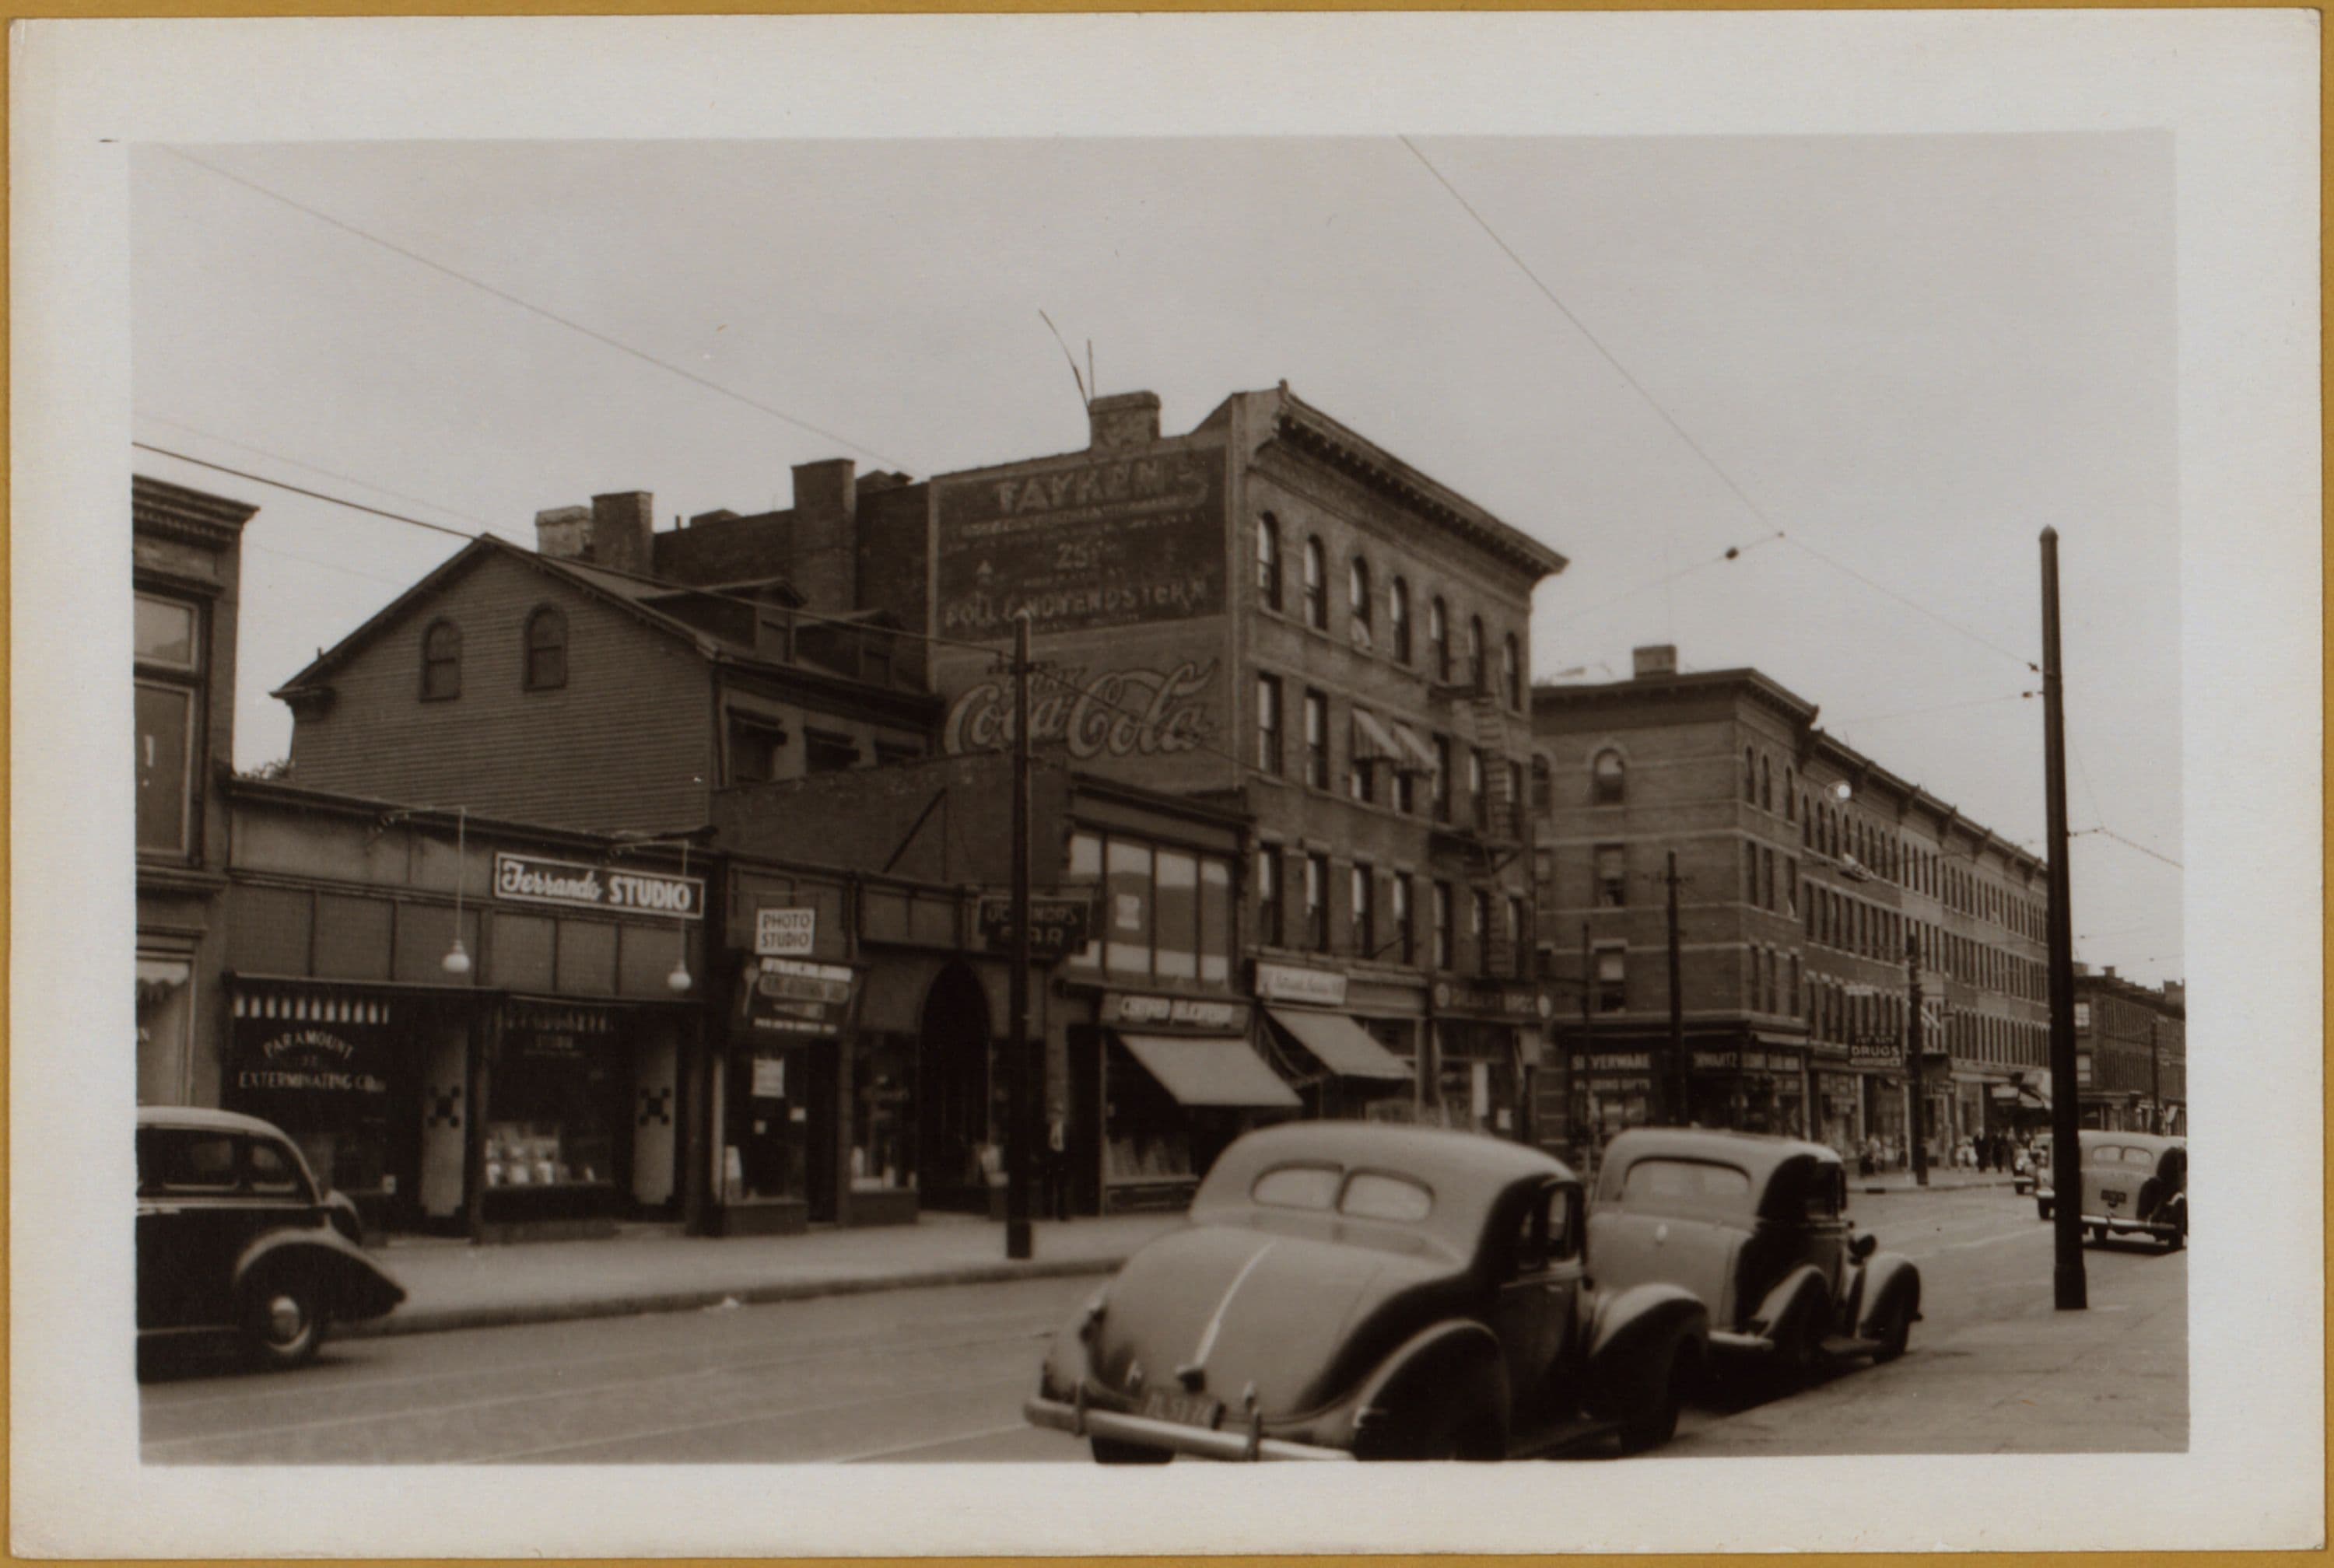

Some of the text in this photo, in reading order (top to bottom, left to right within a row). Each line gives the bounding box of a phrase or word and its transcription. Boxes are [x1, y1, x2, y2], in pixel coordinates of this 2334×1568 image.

[608, 874, 691, 911] STUDIO
[762, 912, 811, 929] PHOTO
[761, 932, 810, 948] STUDIO
[263, 1030, 354, 1059] PARAMOUNT
[1851, 1045, 1900, 1057] DRUGS
[1572, 1052, 1651, 1070] SIVERWARE
